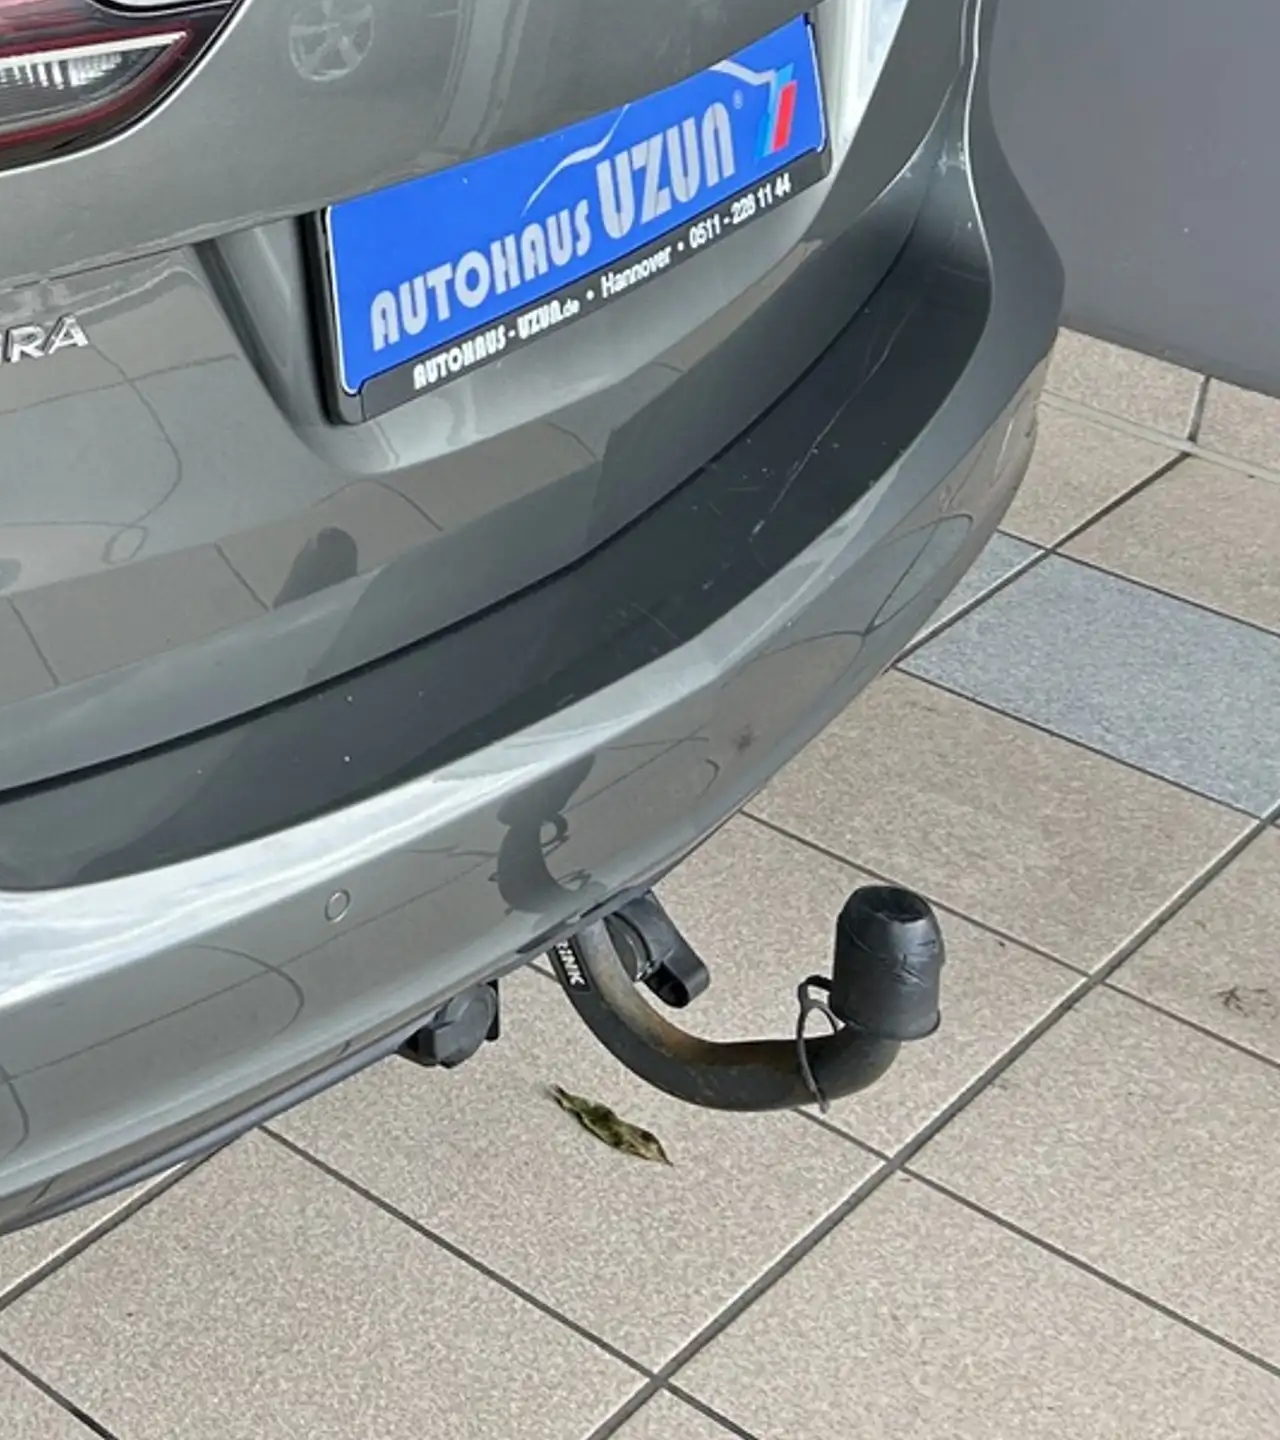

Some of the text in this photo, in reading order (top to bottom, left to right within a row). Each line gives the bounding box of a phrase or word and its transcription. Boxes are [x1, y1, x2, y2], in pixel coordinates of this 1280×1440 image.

[370, 101, 736, 351] AUTOHAUS UZUN
[600, 245, 672, 298] Hannover
[688, 213, 721, 248] 0511
